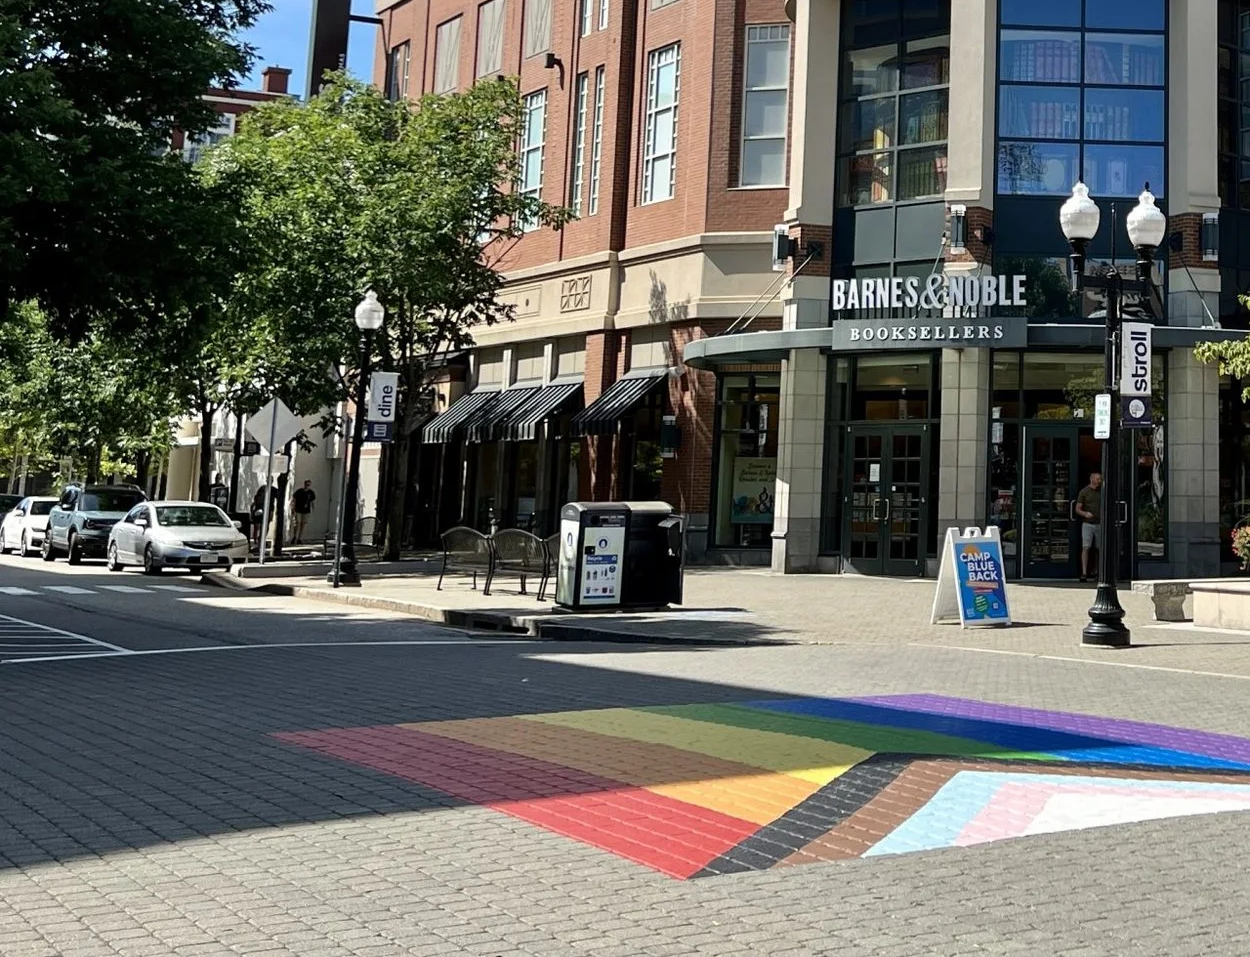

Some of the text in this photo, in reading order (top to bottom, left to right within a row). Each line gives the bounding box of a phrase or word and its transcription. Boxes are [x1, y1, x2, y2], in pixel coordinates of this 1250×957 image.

[850, 325, 1004, 341] BOOKSELLERS
[1130, 331, 1148, 392] stroll
[378, 385, 393, 418] dine
[960, 551, 991, 562] CAMP
[967, 561, 996, 572] BLUE
[969, 571, 999, 582] BACK
